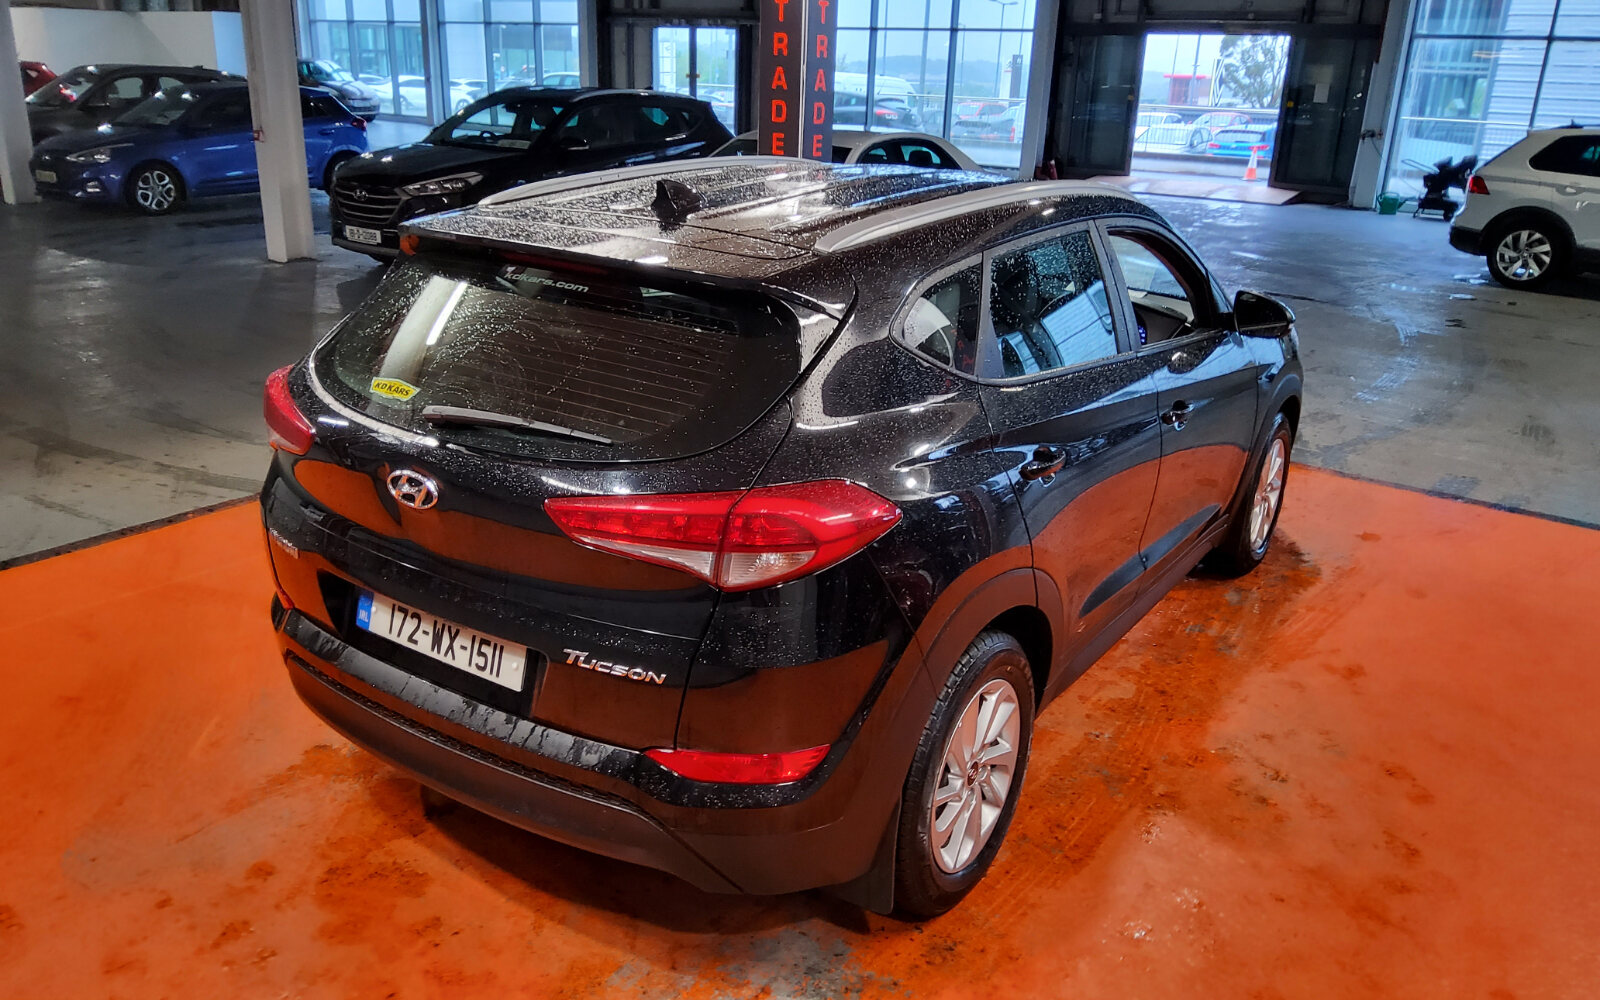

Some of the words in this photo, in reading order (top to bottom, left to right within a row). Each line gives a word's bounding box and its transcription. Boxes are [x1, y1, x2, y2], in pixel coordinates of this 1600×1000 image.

[771, 0, 789, 156] TRADE
[812, 0, 829, 158] TRADE
[503, 271, 590, 293] kdkars.com
[386, 385, 411, 396] KARS
[388, 603, 505, 678] 172-WX-1511
[562, 648, 667, 685] TUCSON
